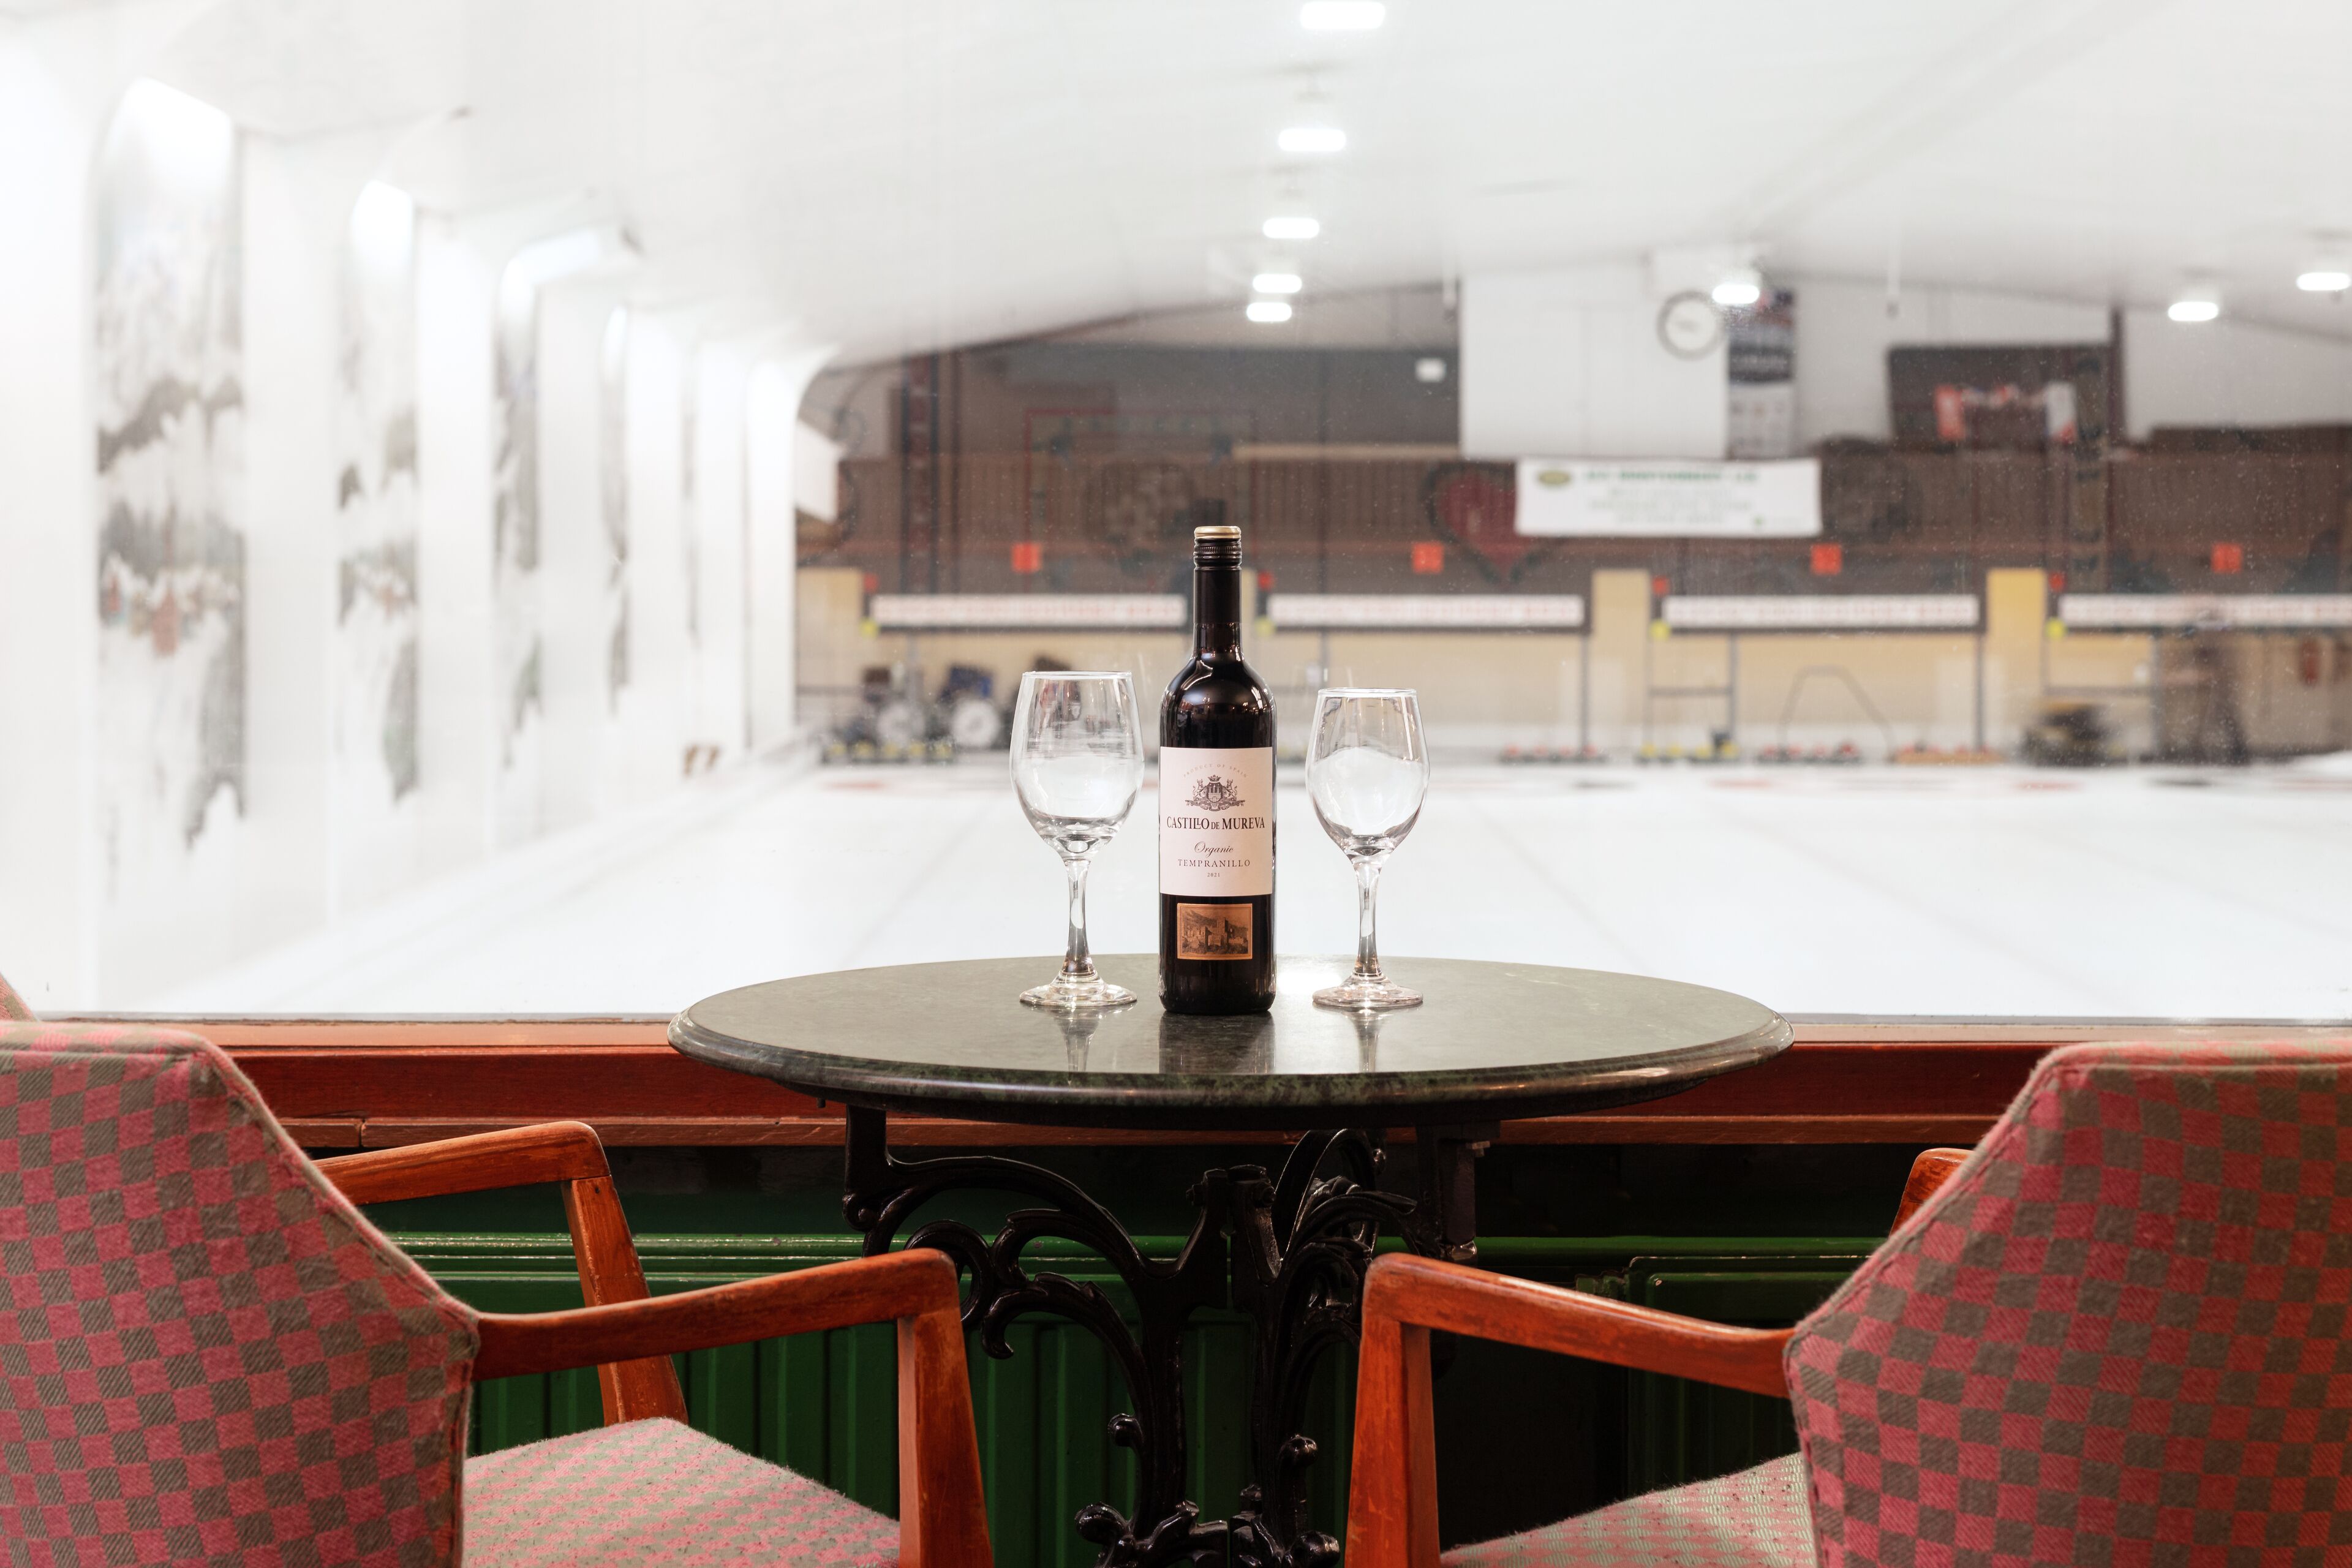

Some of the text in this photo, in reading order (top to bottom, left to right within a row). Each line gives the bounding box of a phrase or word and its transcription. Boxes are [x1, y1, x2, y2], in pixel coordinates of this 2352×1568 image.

[1183, 764, 1212, 778] PRODUCT
[1229, 766, 1247, 778] SPAIN
[1167, 816, 1210, 829] CASTILLO
[1222, 816, 1265, 829] MUREVA
[1194, 841, 1234, 858] Organic
[1178, 859, 1250, 867] TEMPRANILLO
